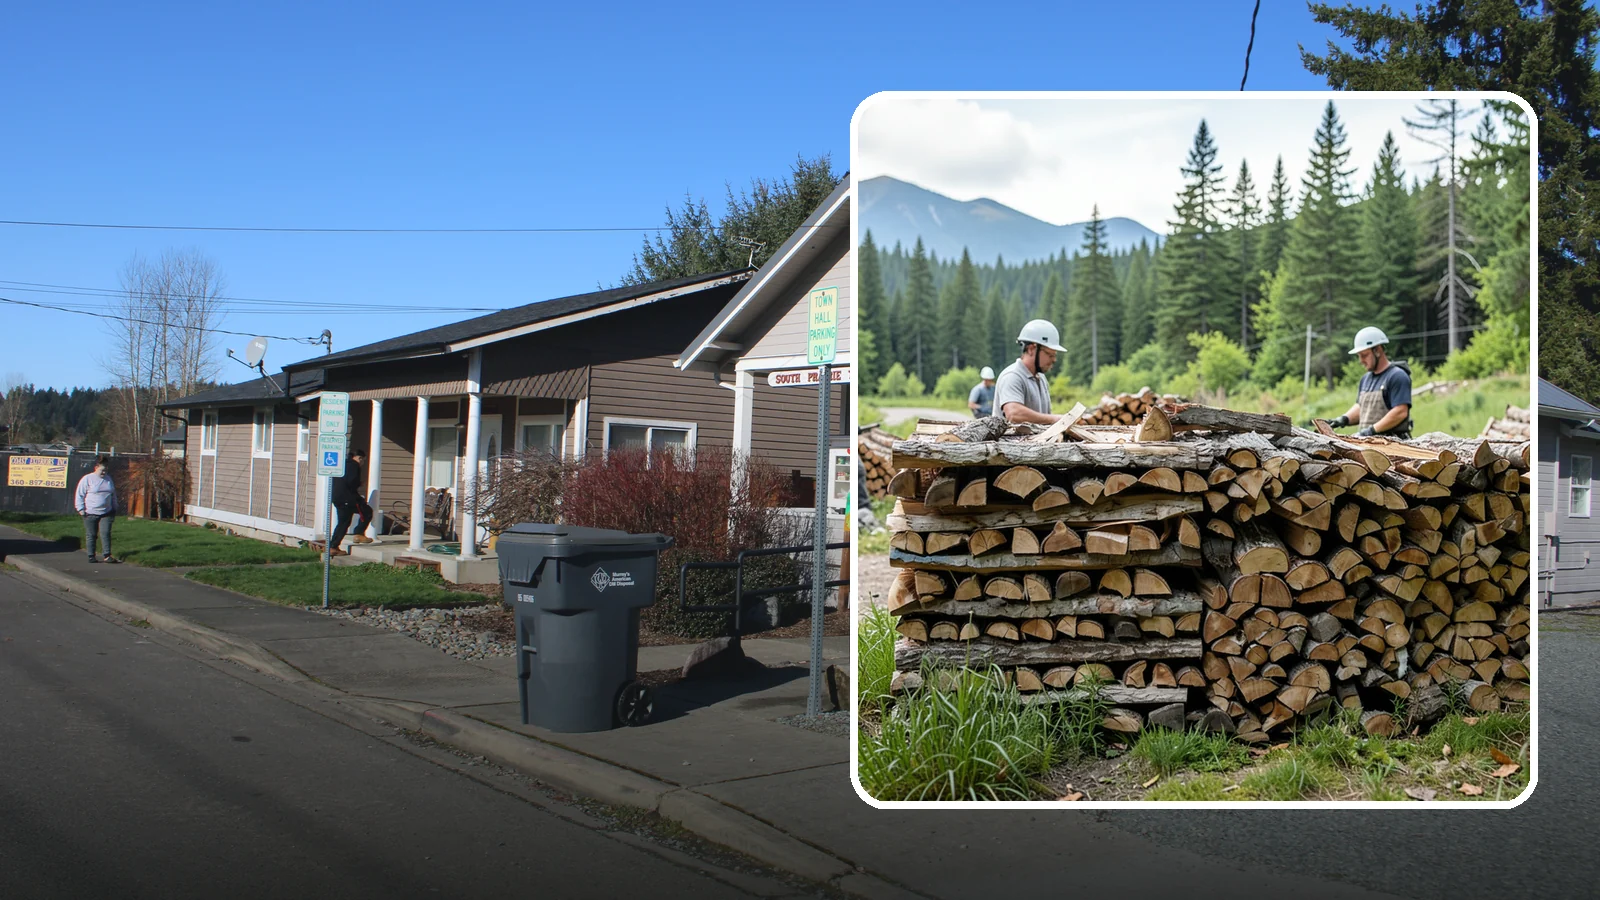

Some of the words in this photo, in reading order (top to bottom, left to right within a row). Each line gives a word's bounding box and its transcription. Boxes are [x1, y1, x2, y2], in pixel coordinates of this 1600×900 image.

[815, 294, 832, 308] TOWN
[815, 312, 831, 324] HALL
[810, 327, 836, 341] PARKING
[814, 344, 831, 357] ONLY
[776, 373, 801, 384] SOUTH
